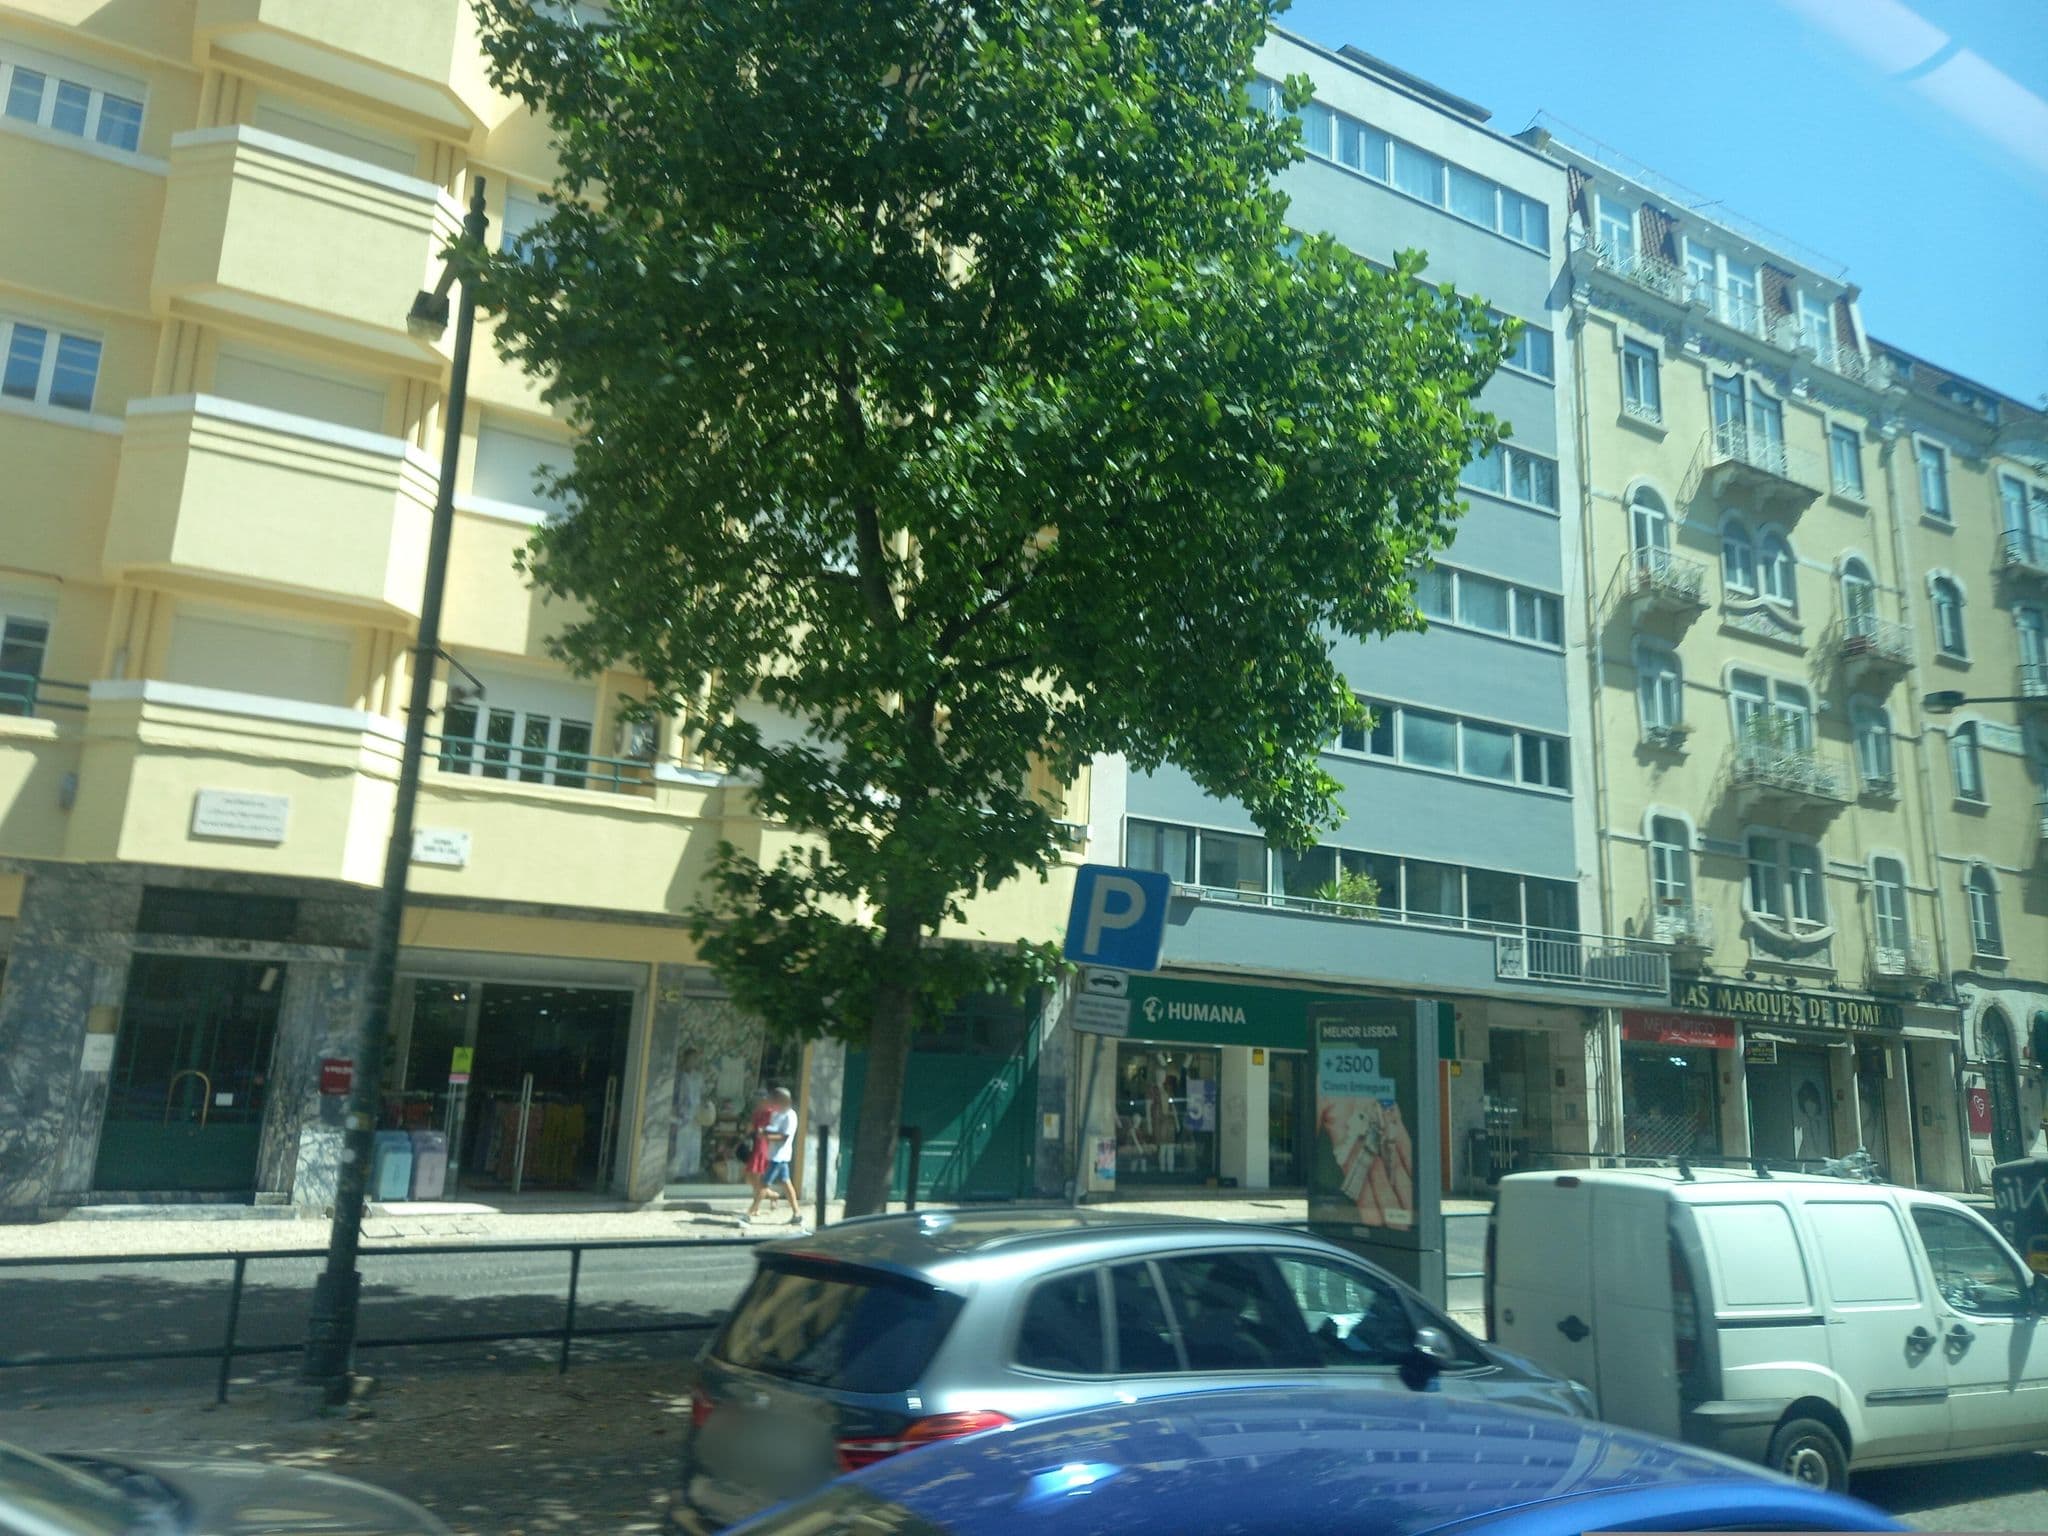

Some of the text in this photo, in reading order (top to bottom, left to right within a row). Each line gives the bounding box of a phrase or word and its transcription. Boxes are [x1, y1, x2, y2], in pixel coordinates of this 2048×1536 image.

[1083, 874, 1146, 955] P
[1168, 1001, 1246, 1024] HUMANA
[1809, 998, 1830, 1020] DE
[1323, 1026, 1398, 1038] MELHOR LISBOA
